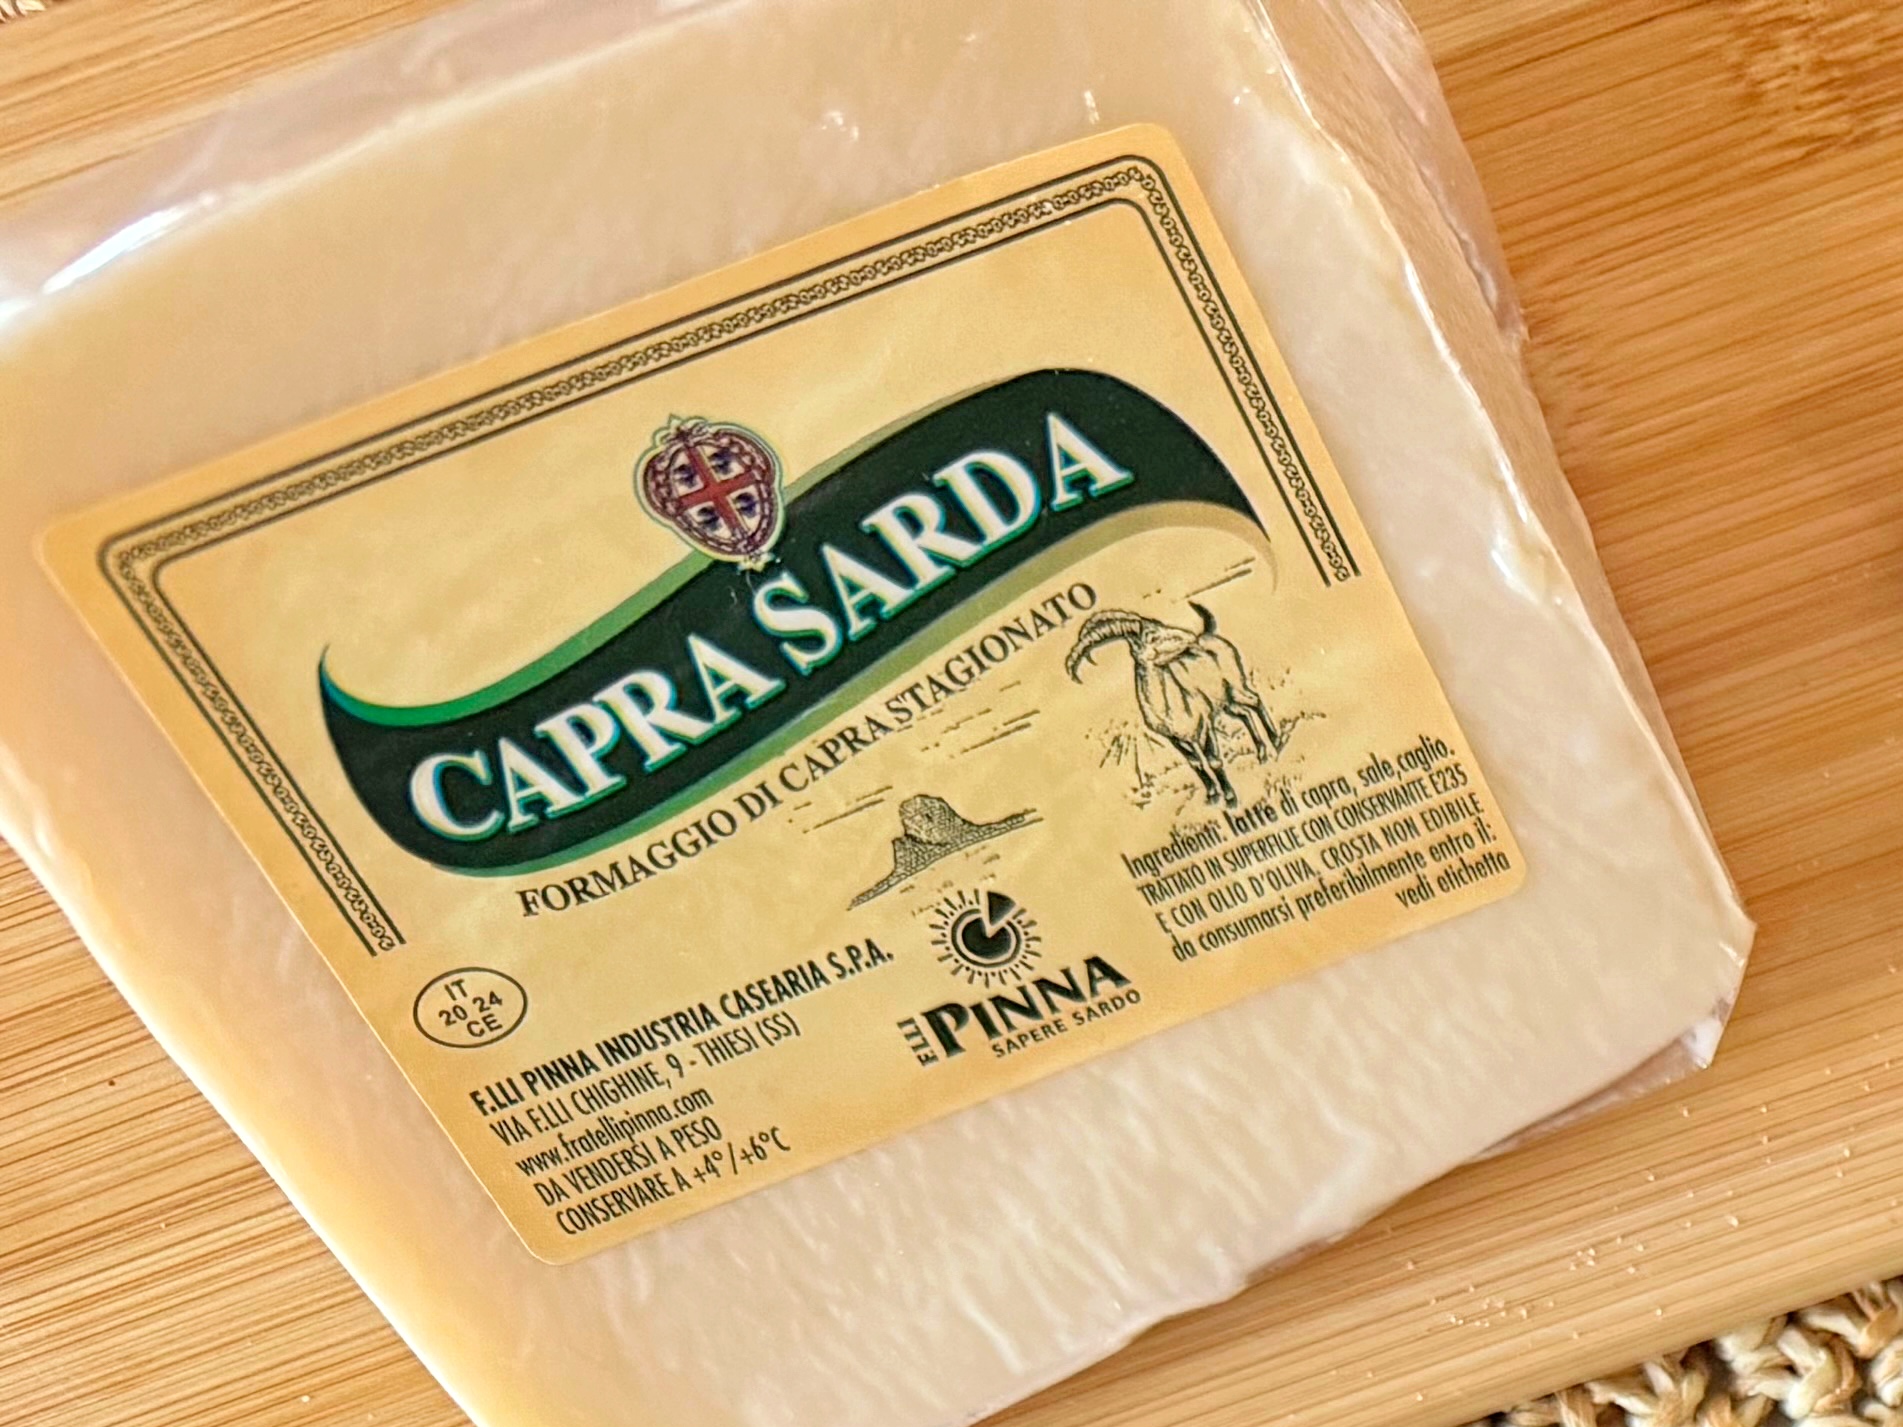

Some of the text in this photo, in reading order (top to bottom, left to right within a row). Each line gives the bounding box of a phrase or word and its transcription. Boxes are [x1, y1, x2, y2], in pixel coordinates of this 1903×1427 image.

[409, 412, 1133, 841] CAPRA SARDA
[516, 580, 1097, 916] FORMAGGIO DI CAPRA STAGIONATO
[1137, 762, 1468, 906] TRATTATO IN SUPERFICIE CON CONSERVANTE E235
[1223, 802, 1279, 837] latte
[1279, 788, 1300, 816] di
[1301, 776, 1358, 810] capra,
[1155, 912, 1172, 934] E
[1171, 898, 1208, 928] CON
[1208, 882, 1248, 913] OLIO
[1320, 832, 1383, 870] CROSTA
[1380, 816, 1421, 848] NON
[1420, 792, 1484, 833] EDIBILE
[1171, 816, 1497, 962] da consumarsi preferibilmente entro il:
[1395, 850, 1511, 909] vedi etichetta
[439, 990, 503, 1027] 20 24
[444, 979, 468, 1001] IT
[466, 1016, 503, 1038] CE
[469, 937, 894, 1117] F.LLI PINNA INDUSTRIA CASEARIA S.P.A.
[921, 955, 1132, 1059] PINNA
[992, 989, 1141, 1058] SAPERE SARDO
[489, 1115, 533, 1146] VIA
[526, 1097, 574, 1134] F.LLI
[570, 1062, 672, 1116] CHIGHINE,
[665, 1053, 685, 1078] 9
[692, 1026, 760, 1067] THIESI
[755, 1011, 801, 1047] (SS)
[515, 1087, 715, 1177] www.fratellipinna.com
[533, 1115, 723, 1207] DA VENDERSI A PESO
[556, 1172, 675, 1235] CONSERVARE
[671, 1167, 693, 1193] A
